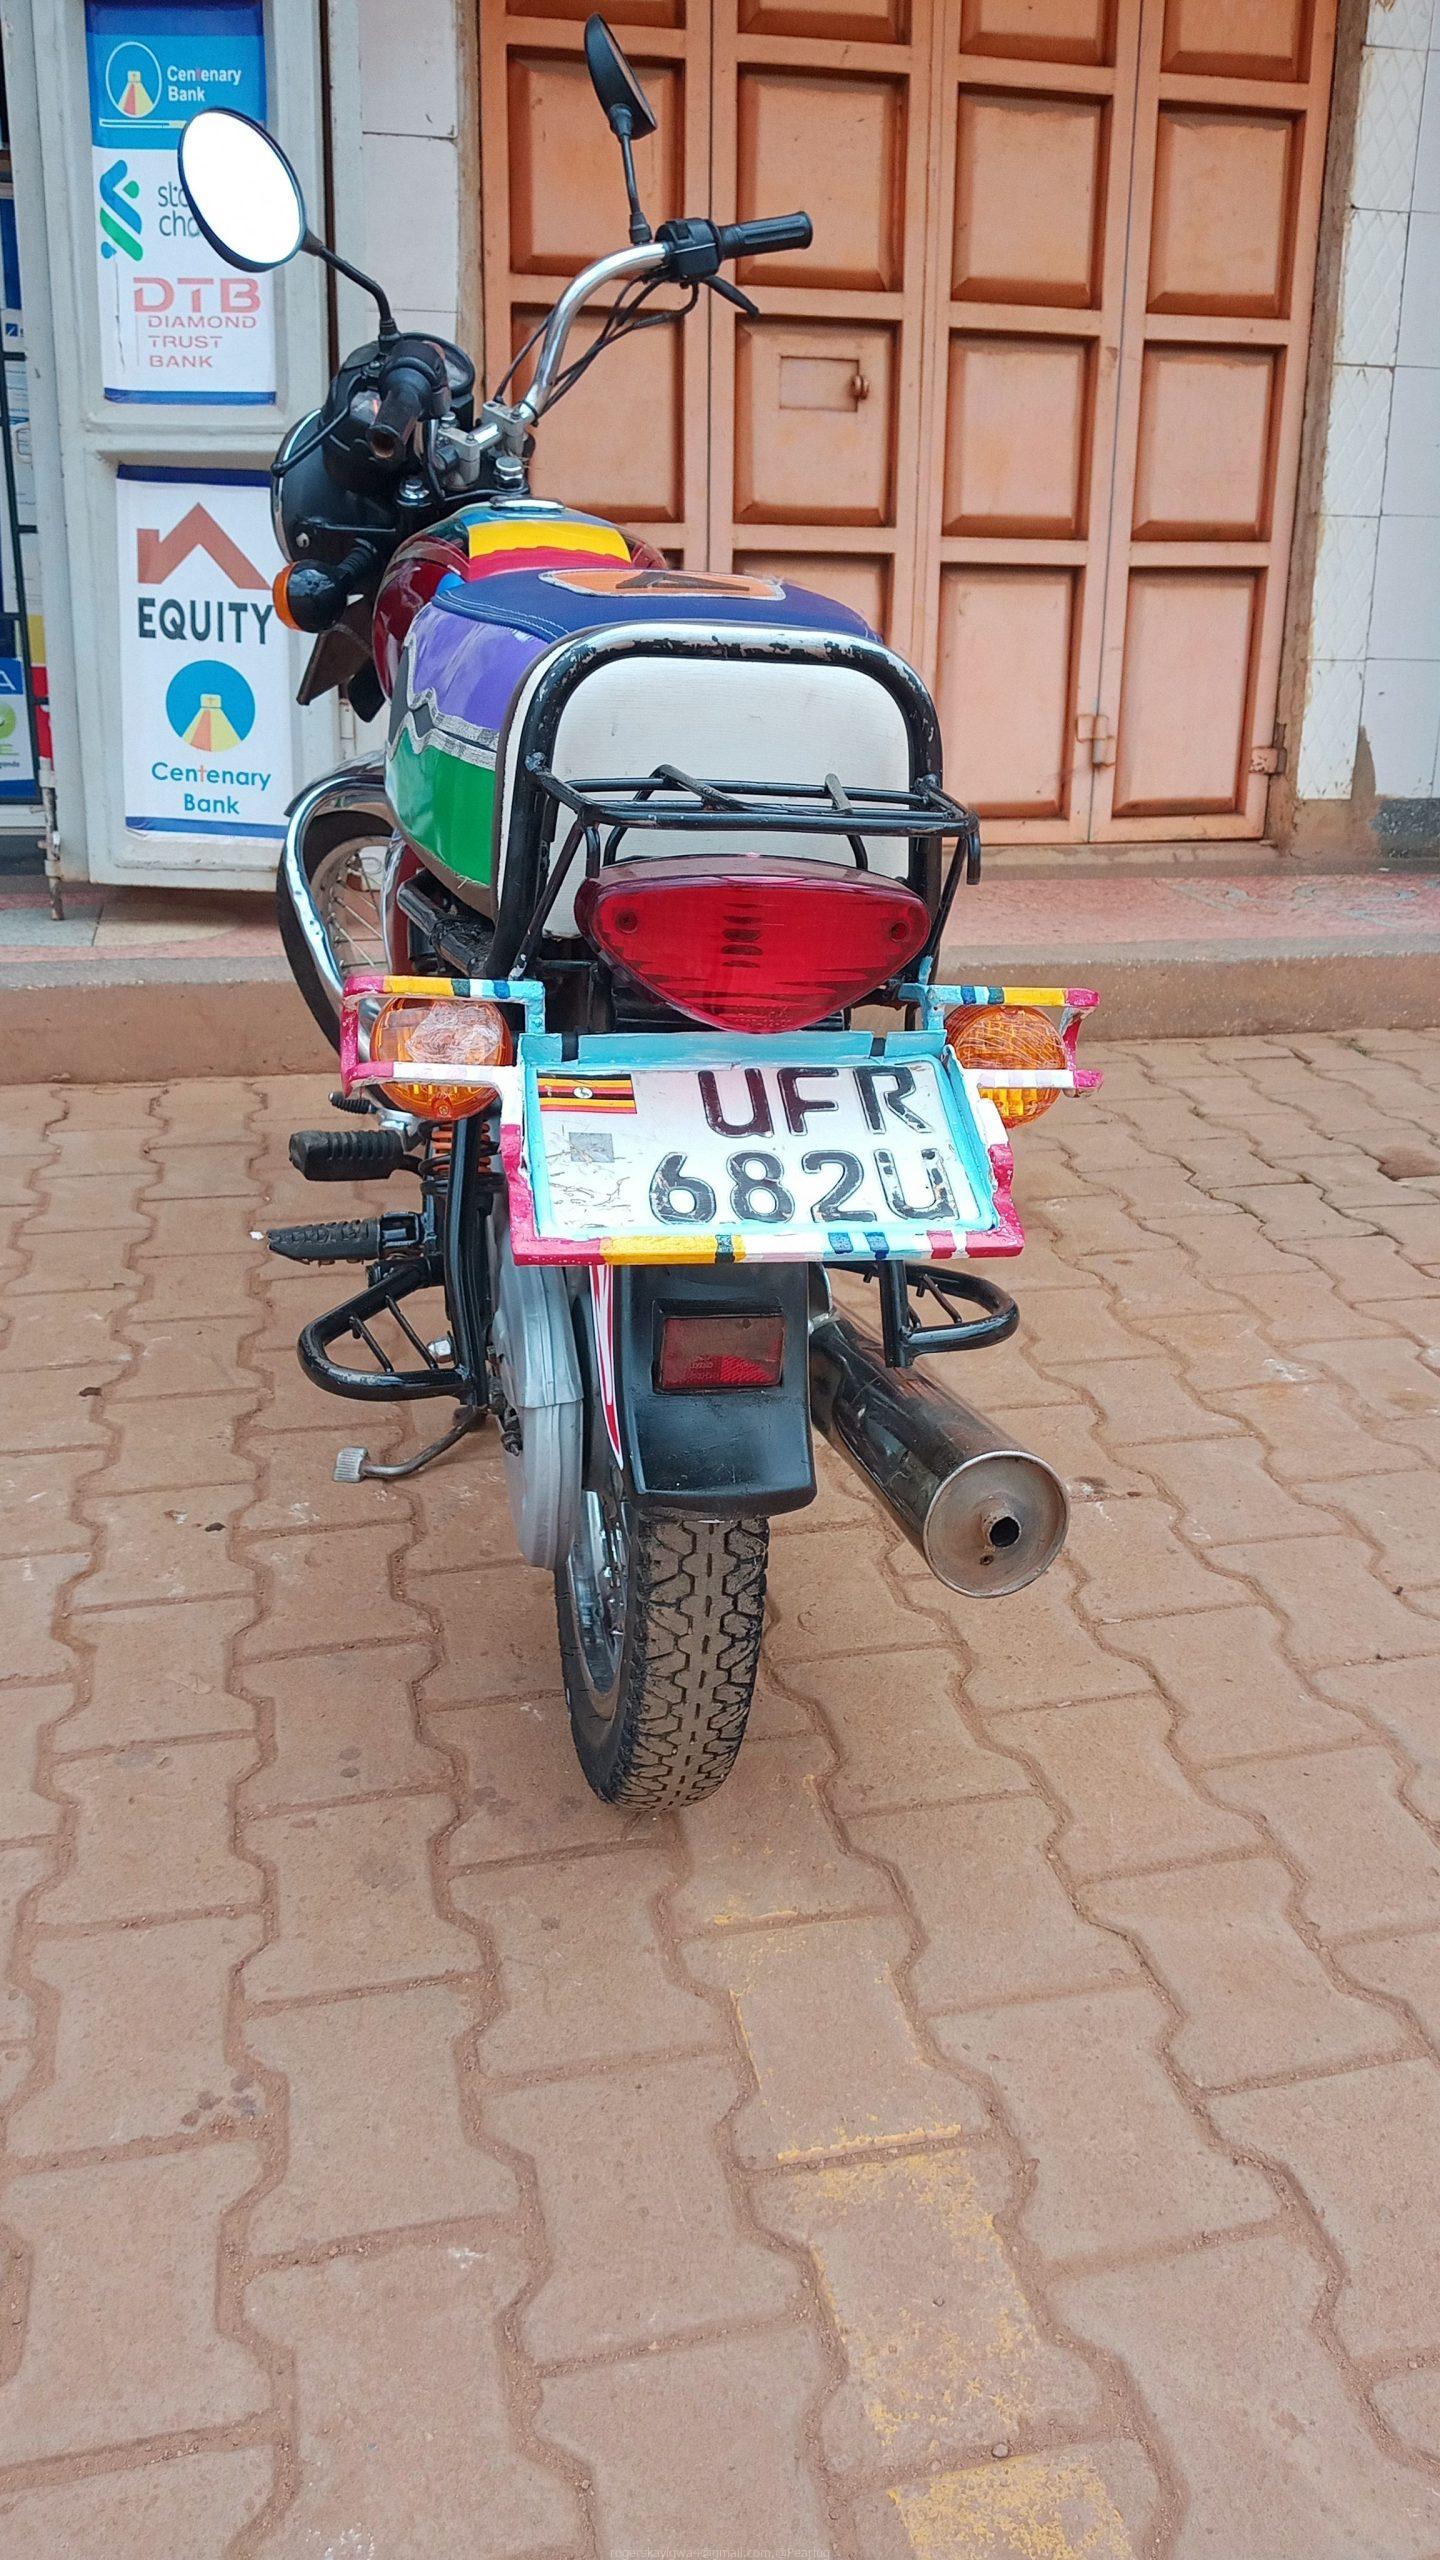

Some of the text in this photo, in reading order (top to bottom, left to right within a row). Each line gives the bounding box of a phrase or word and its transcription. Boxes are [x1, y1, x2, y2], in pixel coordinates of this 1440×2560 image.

[167, 65, 242, 86] Centenary
[168, 85, 206, 102] Bank
[133, 277, 262, 313] DTB
[148, 315, 257, 329] DIAMOND
[148, 335, 223, 349] TRUST
[149, 355, 214, 368] BANK
[138, 597, 274, 645] EQUITY
[151, 762, 271, 791] Centenary
[184, 793, 240, 815] Bank
[698, 1065, 933, 1138] UFR
[648, 1147, 959, 1224] 682U
